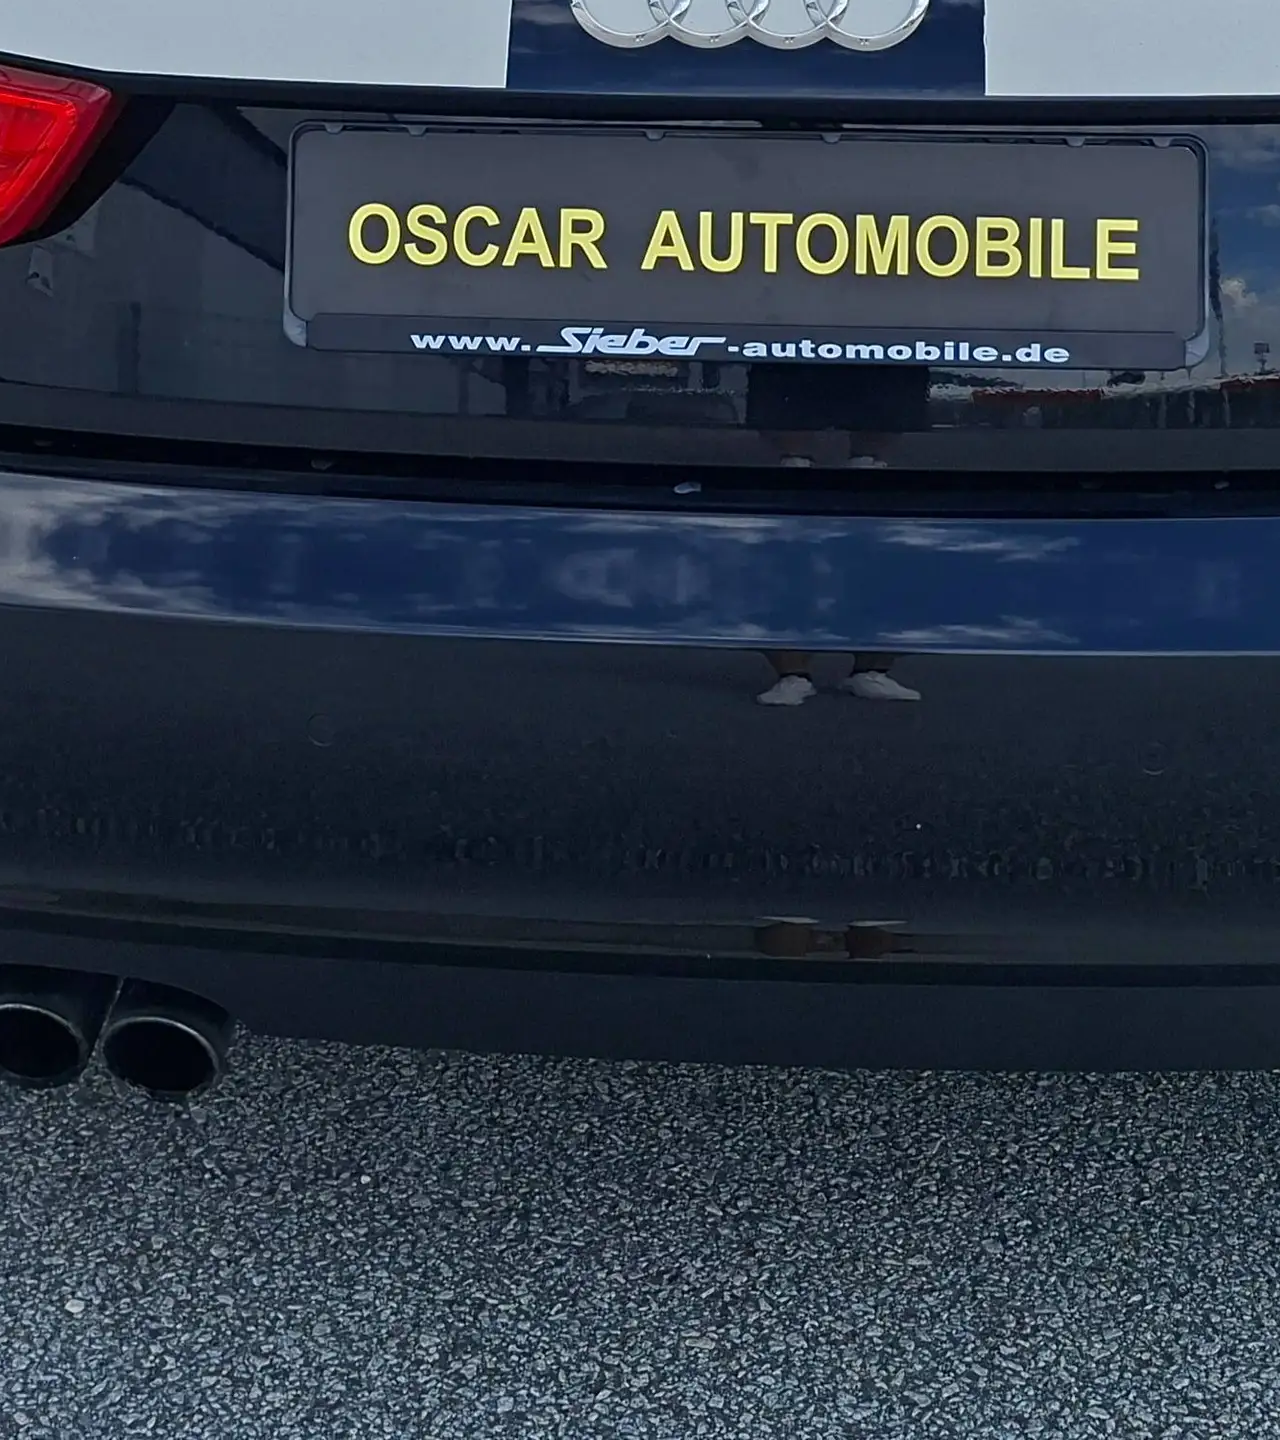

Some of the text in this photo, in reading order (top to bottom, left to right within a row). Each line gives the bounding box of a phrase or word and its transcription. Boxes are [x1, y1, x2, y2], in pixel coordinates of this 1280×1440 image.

[348, 203, 1140, 281] OSCAR AUTOMOBILE
[410, 326, 1070, 364] www.Sieber-automobile.de
